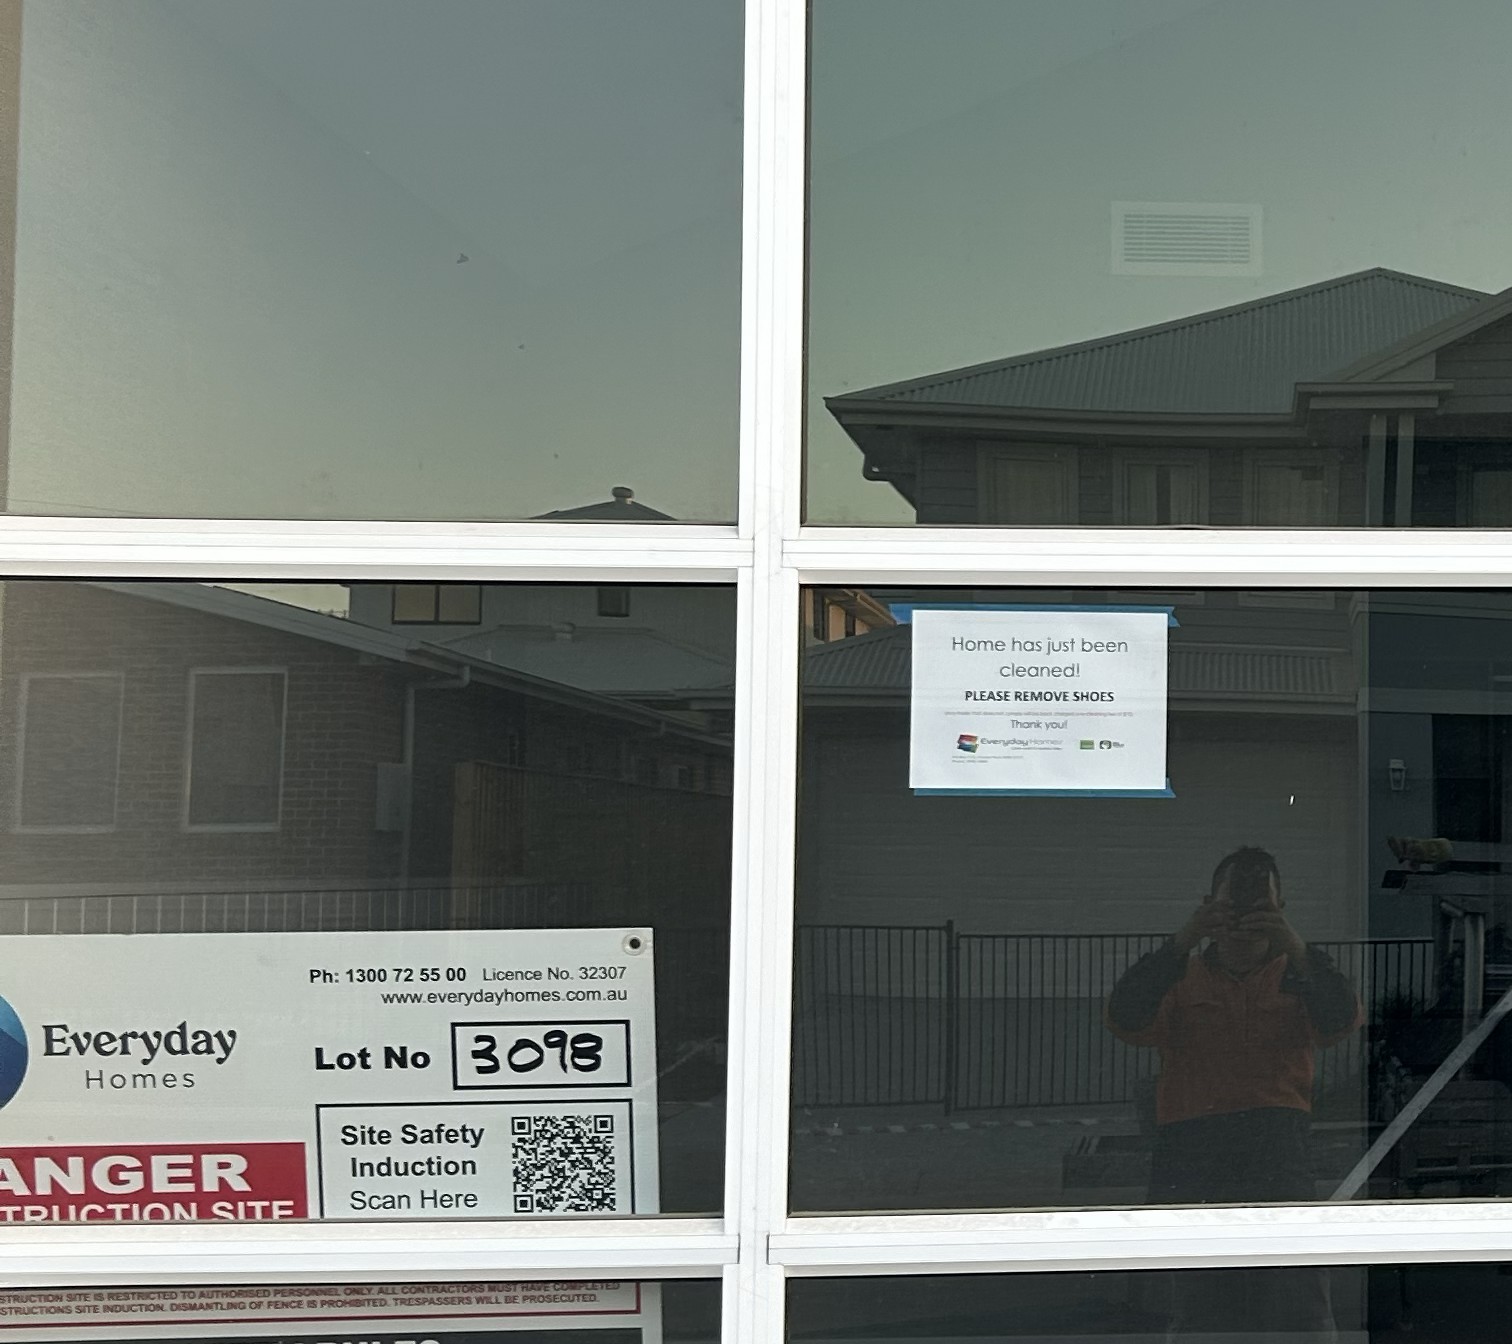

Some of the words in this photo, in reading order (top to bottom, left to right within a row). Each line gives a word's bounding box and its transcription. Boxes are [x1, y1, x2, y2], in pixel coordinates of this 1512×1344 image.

[952, 637, 1006, 652] Home
[1012, 638, 1042, 652] has
[1046, 638, 1075, 656] just
[1082, 638, 1128, 653] been
[1000, 662, 1080, 678] cleaned!
[965, 690, 1010, 702] PLEASE
[1014, 691, 1070, 702] REMOVE
[1074, 691, 1114, 702] SHOES
[1010, 719, 1042, 730] Thank
[1046, 719, 1068, 732] you!
[980, 738, 1028, 746] Everyday
[310, 969, 340, 983] Ph:
[346, 968, 388, 982] 1300
[393, 968, 414, 982] 72
[419, 968, 440, 982] 55
[446, 967, 467, 982] 00
[482, 967, 542, 982] Licence
[548, 967, 574, 980] No.
[578, 966, 626, 980] 32307
[380, 988, 628, 1006] www.everydayhomes.com.au
[42, 1021, 236, 1066] Everyday
[471, 1030, 602, 1074] 3098
[315, 1047, 372, 1070] Lot
[384, 1046, 430, 1070] No
[86, 1070, 195, 1090] Homes
[340, 1124, 392, 1146] Site
[400, 1124, 484, 1148] Safety
[350, 1156, 476, 1178] Induction
[350, 1190, 410, 1210] Scan
[420, 1189, 478, 1208] Here
[211, 1200, 294, 1220] SITE
[74, 1304, 99, 1314] SITE
[102, 1302, 165, 1313] INDUCTION.
[169, 1300, 246, 1311] DISMANTLING
[248, 1300, 263, 1310] OF
[266, 1299, 303, 1309] FENCE
[306, 1299, 317, 1308] IS
[320, 1297, 387, 1308] PROHIBITED.
[392, 1295, 472, 1306] TRESPASSERS
[474, 1294, 501, 1305] WILL
[504, 1294, 518, 1304] BE
[522, 1292, 598, 1304] PROSECUTED.
